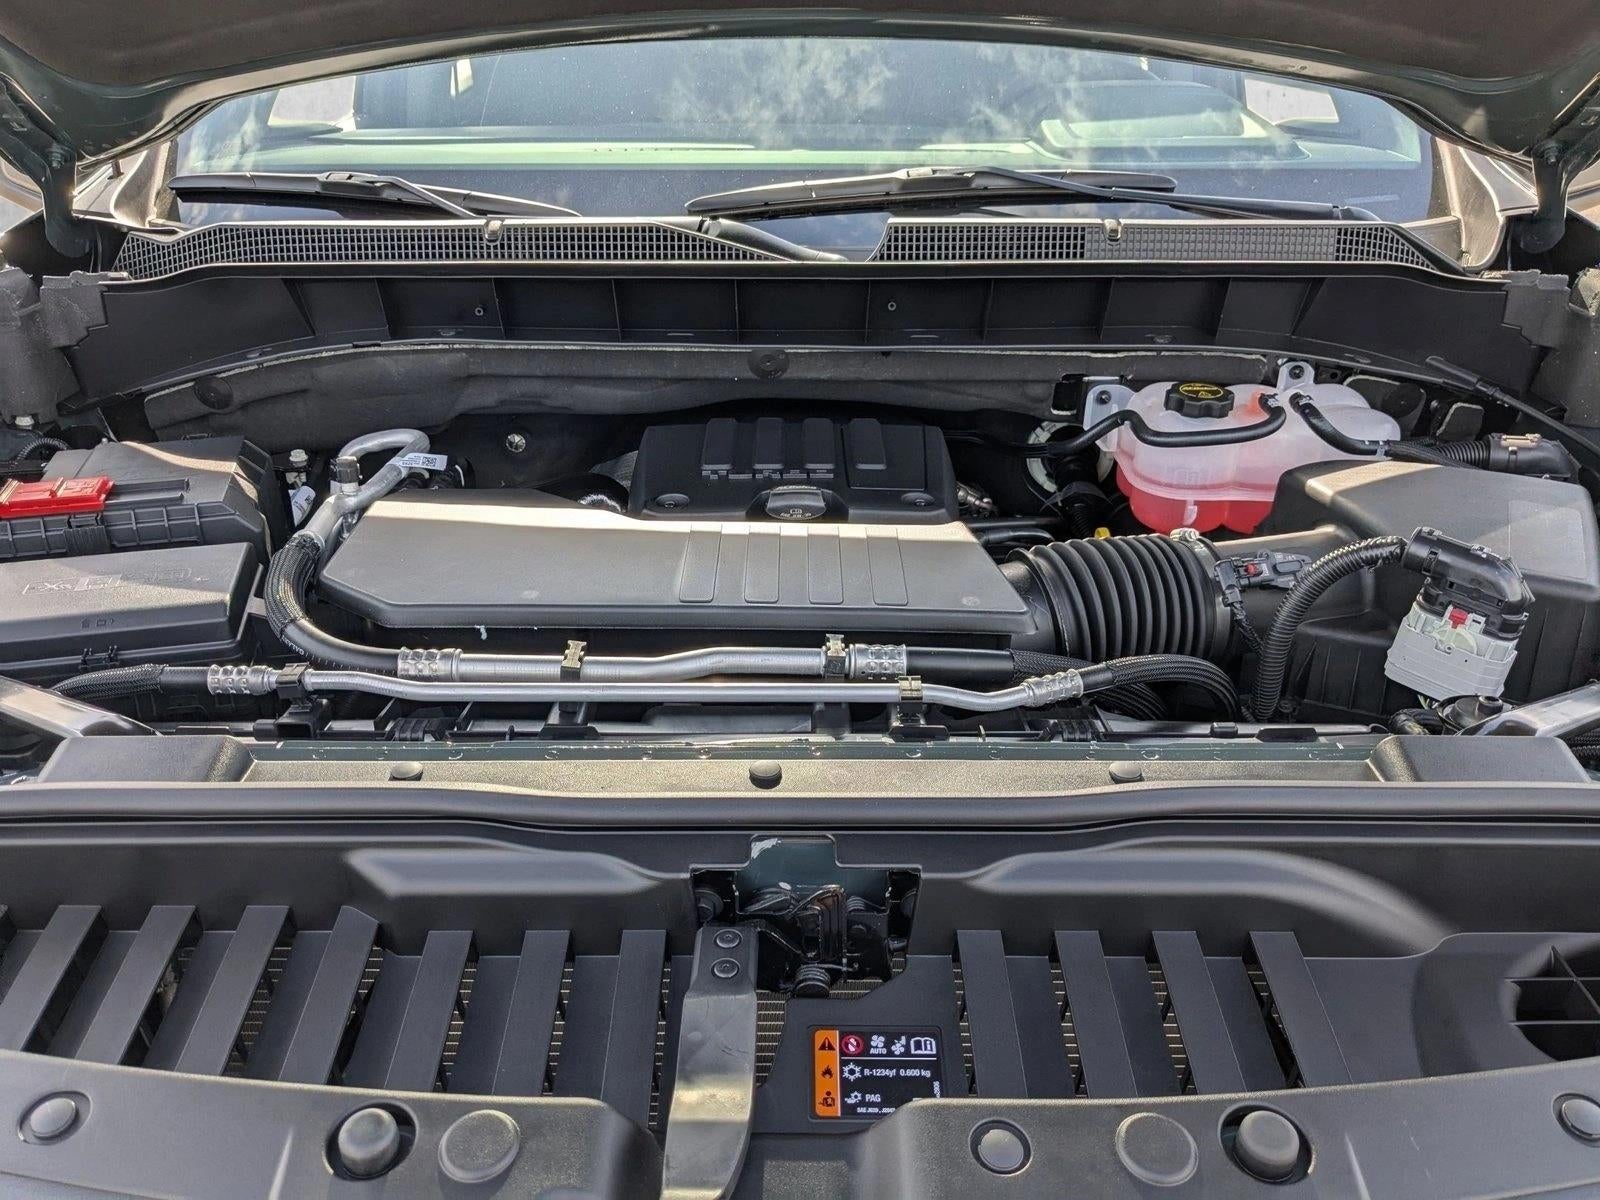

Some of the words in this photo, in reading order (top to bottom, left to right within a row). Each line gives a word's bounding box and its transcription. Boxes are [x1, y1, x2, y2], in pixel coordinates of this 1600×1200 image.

[869, 1047, 887, 1055] AUTO
[863, 1068, 896, 1078] R-1234yf
[920, 1068, 931, 1078] kg
[865, 1093, 881, 1102] PAG
